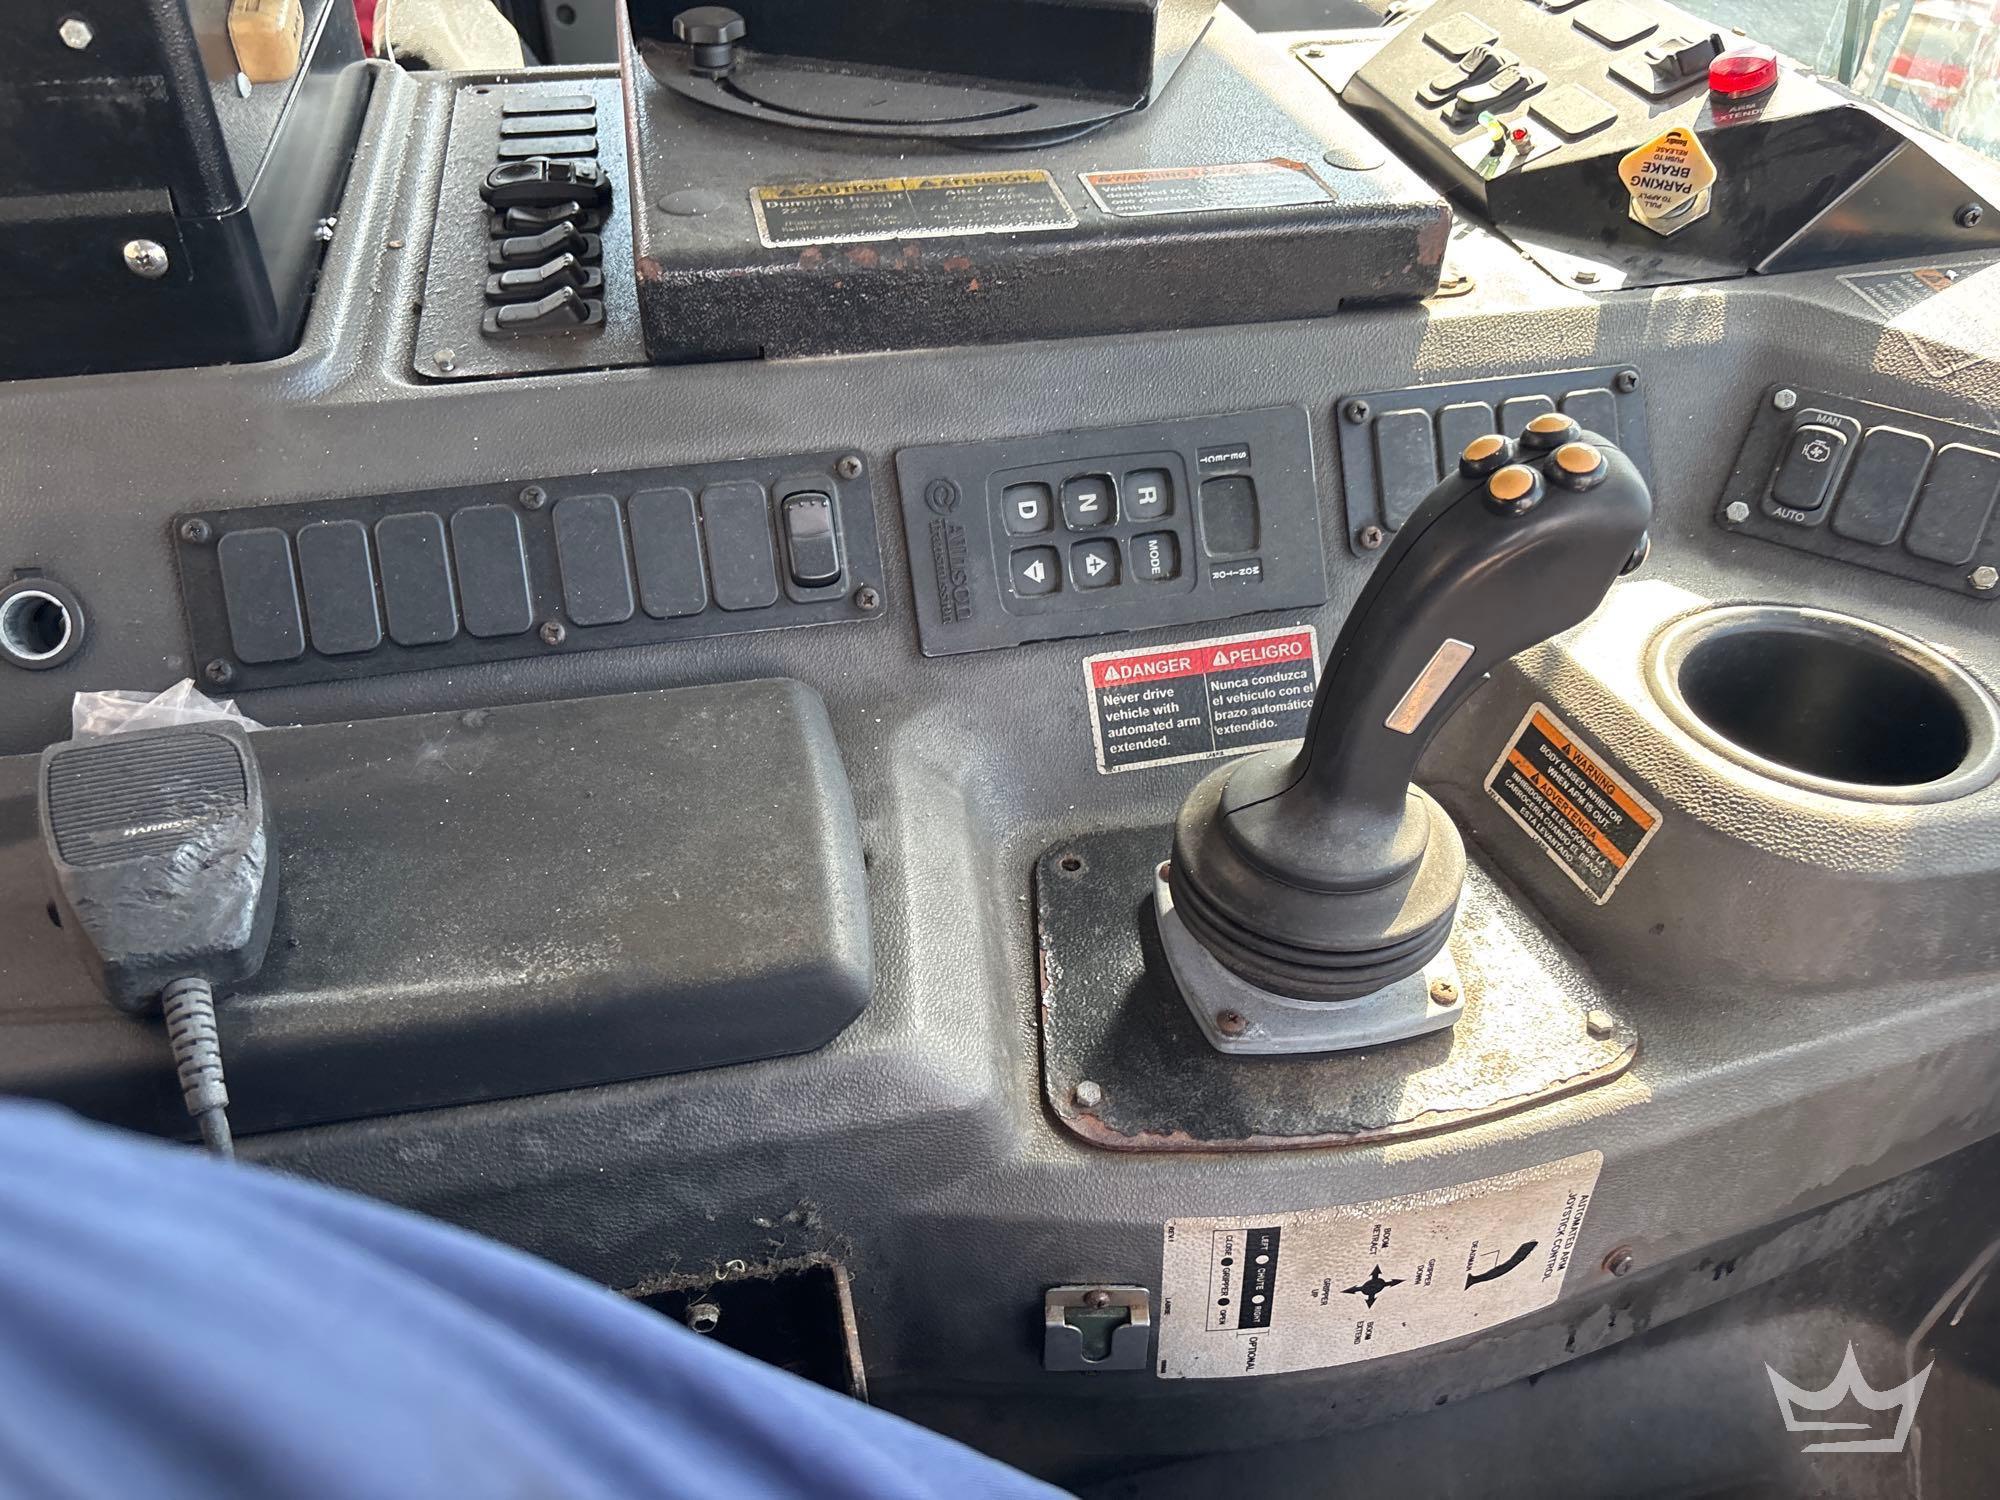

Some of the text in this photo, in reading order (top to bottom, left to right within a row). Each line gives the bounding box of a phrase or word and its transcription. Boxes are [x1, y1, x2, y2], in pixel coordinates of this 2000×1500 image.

[1655, 147, 1689, 156] RELEASE
[1664, 155, 1685, 163] PUSH
[1640, 161, 1691, 178] BRAKE
[798, 183, 887, 196] CAUTION
[1101, 184, 1149, 193] Vehicle
[1106, 189, 1167, 199] designed
[1630, 175, 1693, 194] PARKING
[766, 198, 845, 210] Dumping
[1639, 192, 1661, 201] APPLY
[1644, 201, 1662, 209] PULL
[1115, 204, 1145, 212] only
[1816, 414, 1842, 427] MAN
[1199, 451, 1247, 464] SELECT
[1078, 493, 1098, 512] N
[1138, 486, 1158, 505] R
[1018, 500, 1038, 519] D
[1772, 507, 1805, 522] AUTO
[1148, 539, 1161, 575] MODE
[1212, 565, 1260, 580] MONITOR
[1229, 641, 1303, 665] PELIGRO
[1120, 657, 1192, 679] DANGER
[1210, 670, 1308, 692] Nunca conduzca
[1103, 688, 1175, 707] Never drive
[1212, 694, 1224, 706] el
[1278, 686, 1301, 697] con
[1303, 682, 1314, 693] el
[1105, 702, 1180, 722] vehicle with
[1214, 698, 1314, 722] brazo automático
[1107, 716, 1201, 738] automated arm
[1216, 718, 1278, 736] extendido.
[1109, 735, 1171, 754] extended.
[1573, 751, 1616, 795] WARNING
[1539, 744, 1623, 825] BODY RAISED INHIBITOR
[1547, 765, 1570, 789] WHEN
[1584, 801, 1594, 813] IS
[1511, 771, 1607, 869] INHIBIDOR DE ELEVACIÓN DE LA
[1540, 782, 1597, 841] ADVERTENCIA
[1543, 817, 1571, 846] CUANDO
[1569, 843, 1579, 855] EL
[1578, 852, 1603, 878] BRAZO
[1369, 1224, 1382, 1255] RETRACT
[1381, 1227, 1392, 1249] BOOM
[1541, 1190, 1578, 1283] JOYSTICK CONTROL
[1557, 1194, 1590, 1272] AUTOMATED ARM
[1465, 1240, 1479, 1272] DEADMAN
[1218, 1234, 1234, 1325] CLOSE GRIPPER OPEN
[1253, 1234, 1270, 1323] LEFT CHUTE RIGHT
[1414, 1264, 1425, 1285] DOWN
[1423, 1258, 1436, 1287] GRIPPER
[1311, 1288, 1319, 1298] UP
[1320, 1277, 1332, 1307] GRIPPER
[1353, 1320, 1365, 1345] EXTEND
[1364, 1321, 1374, 1341] BOOM
[1245, 1336, 1259, 1372] OPTIONAL
